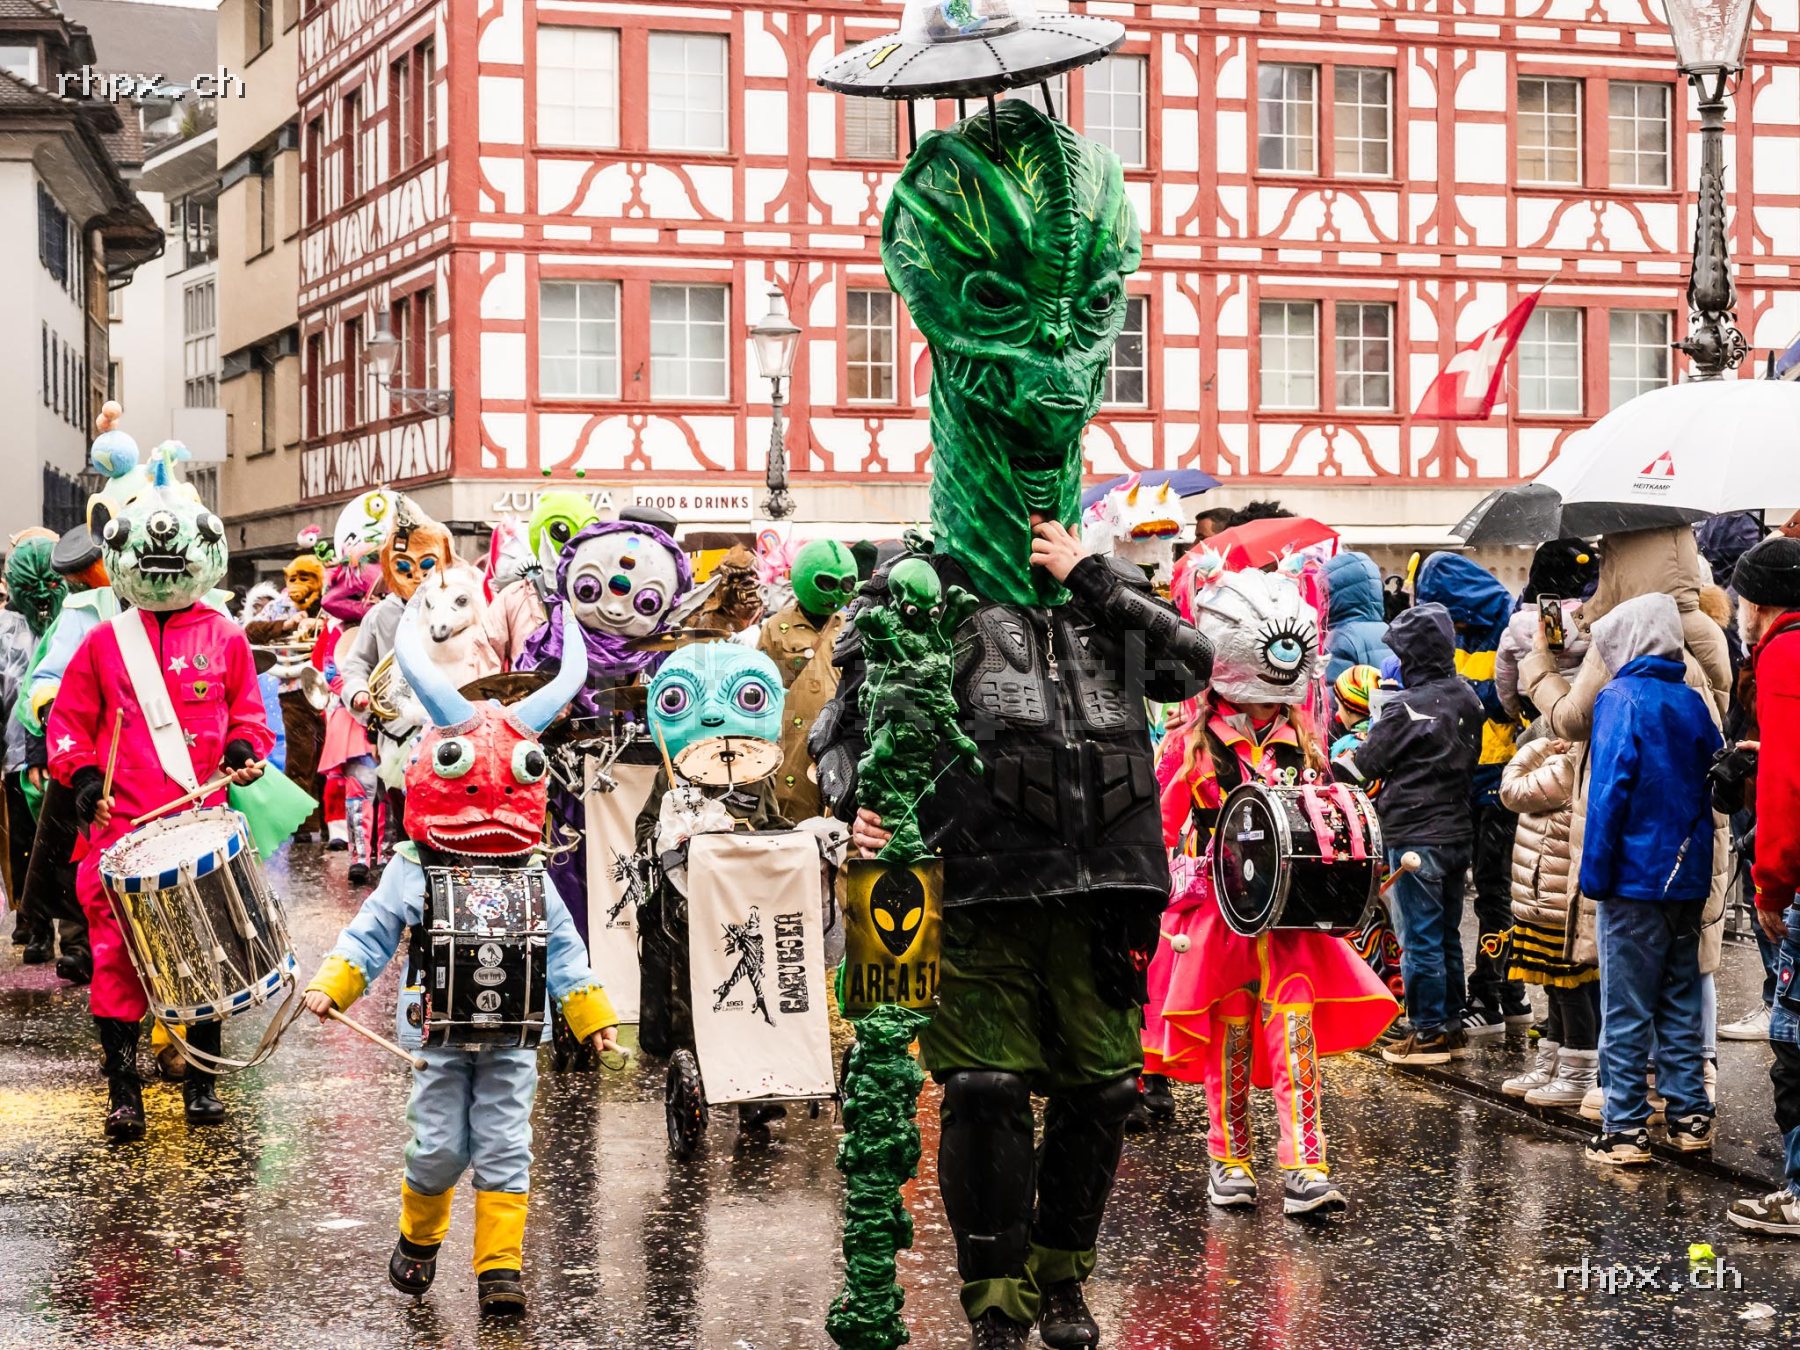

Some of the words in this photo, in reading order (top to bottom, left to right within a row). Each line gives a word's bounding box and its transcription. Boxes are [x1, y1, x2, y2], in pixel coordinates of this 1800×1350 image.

[636, 496, 675, 508] FOOD
[679, 496, 689, 509] &
[694, 496, 750, 509] DRINKS
[849, 963, 910, 1002] AREA
[915, 960, 937, 1001] 51
[726, 999, 744, 1007] 1963
